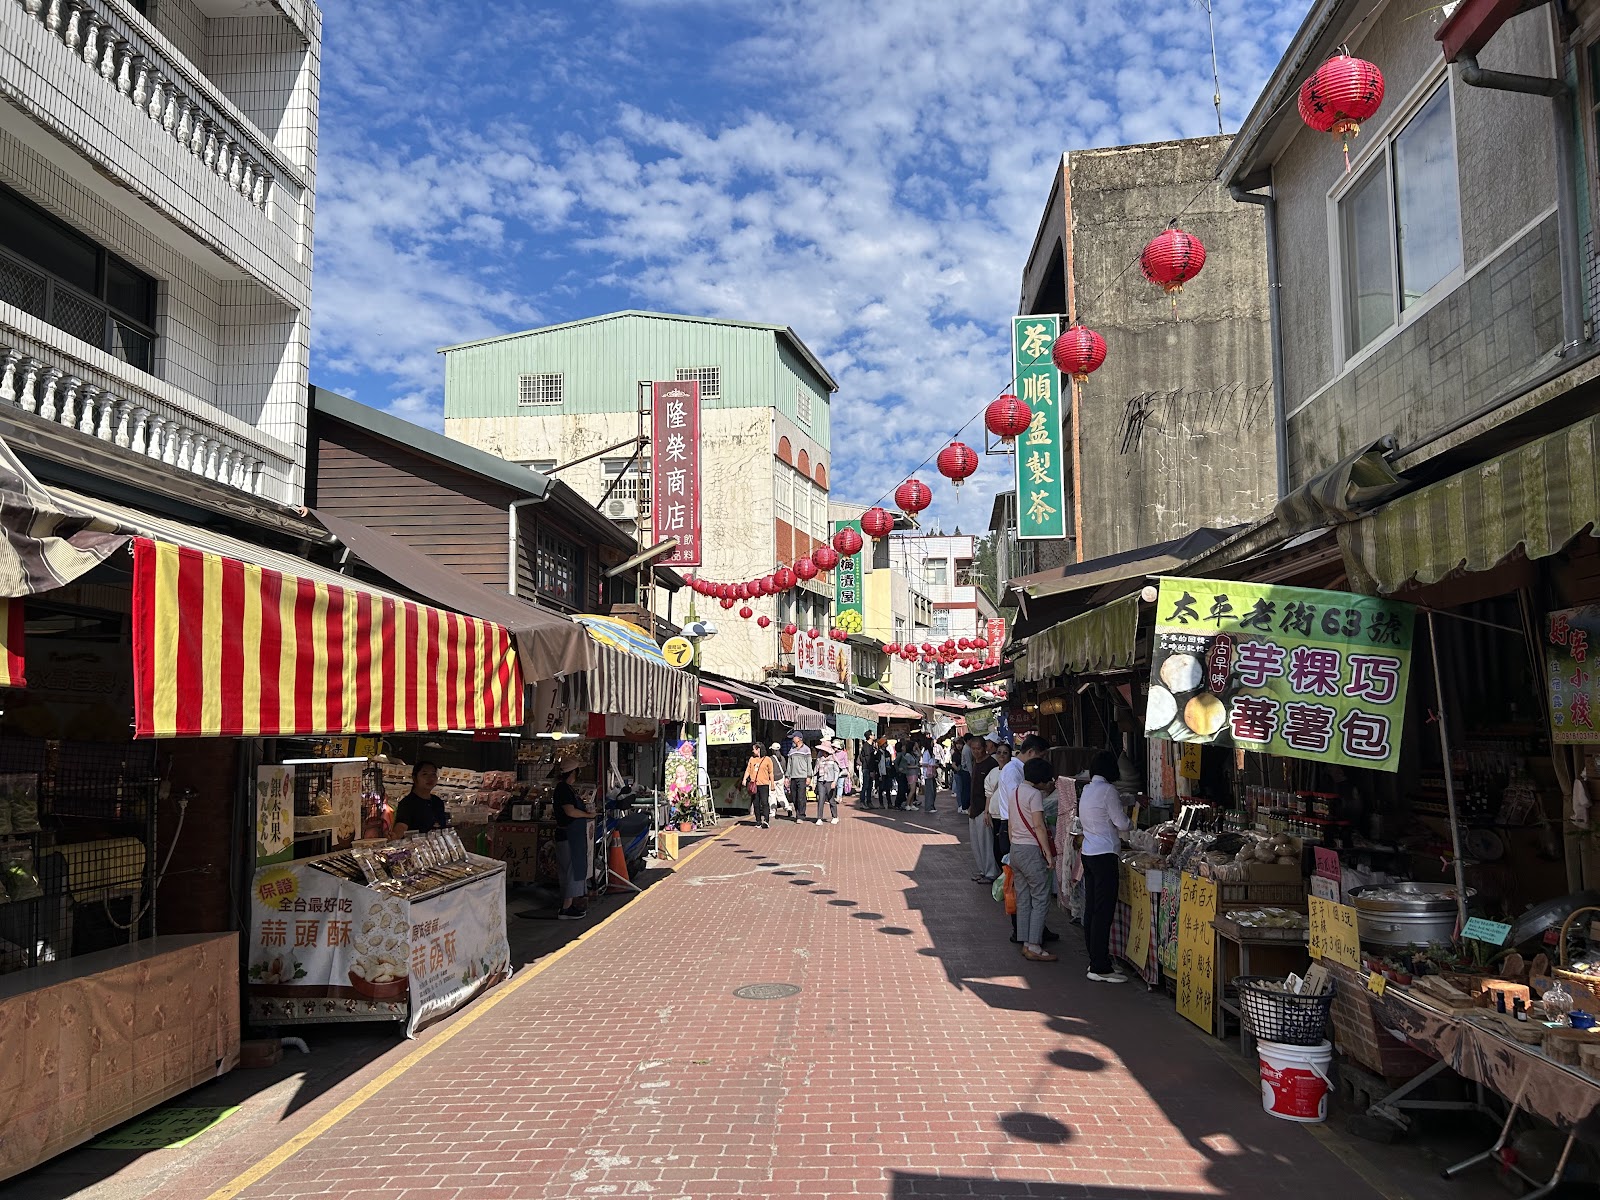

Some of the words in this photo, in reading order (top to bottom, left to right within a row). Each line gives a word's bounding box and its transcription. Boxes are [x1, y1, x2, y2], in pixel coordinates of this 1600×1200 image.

[1021, 324, 1052, 358] 茶
[665, 399, 687, 531] 隆榮商店
[1022, 372, 1057, 525] 順益製茶
[1165, 591, 1402, 645] 太平老街63號
[1211, 641, 1230, 686] 古早味
[1236, 641, 1402, 704] 芋粿巧
[1549, 614, 1594, 729] 好客小棧
[1550, 660, 1564, 727] 住宿露營
[1230, 696, 1390, 761] 蕃薯包
[270, 777, 281, 843] 銀杏果
[258, 877, 294, 899] 保證
[278, 897, 353, 914] 全台最好吃
[260, 918, 352, 949] 蒜頭酥
[411, 929, 457, 980] 蒜頭酥
